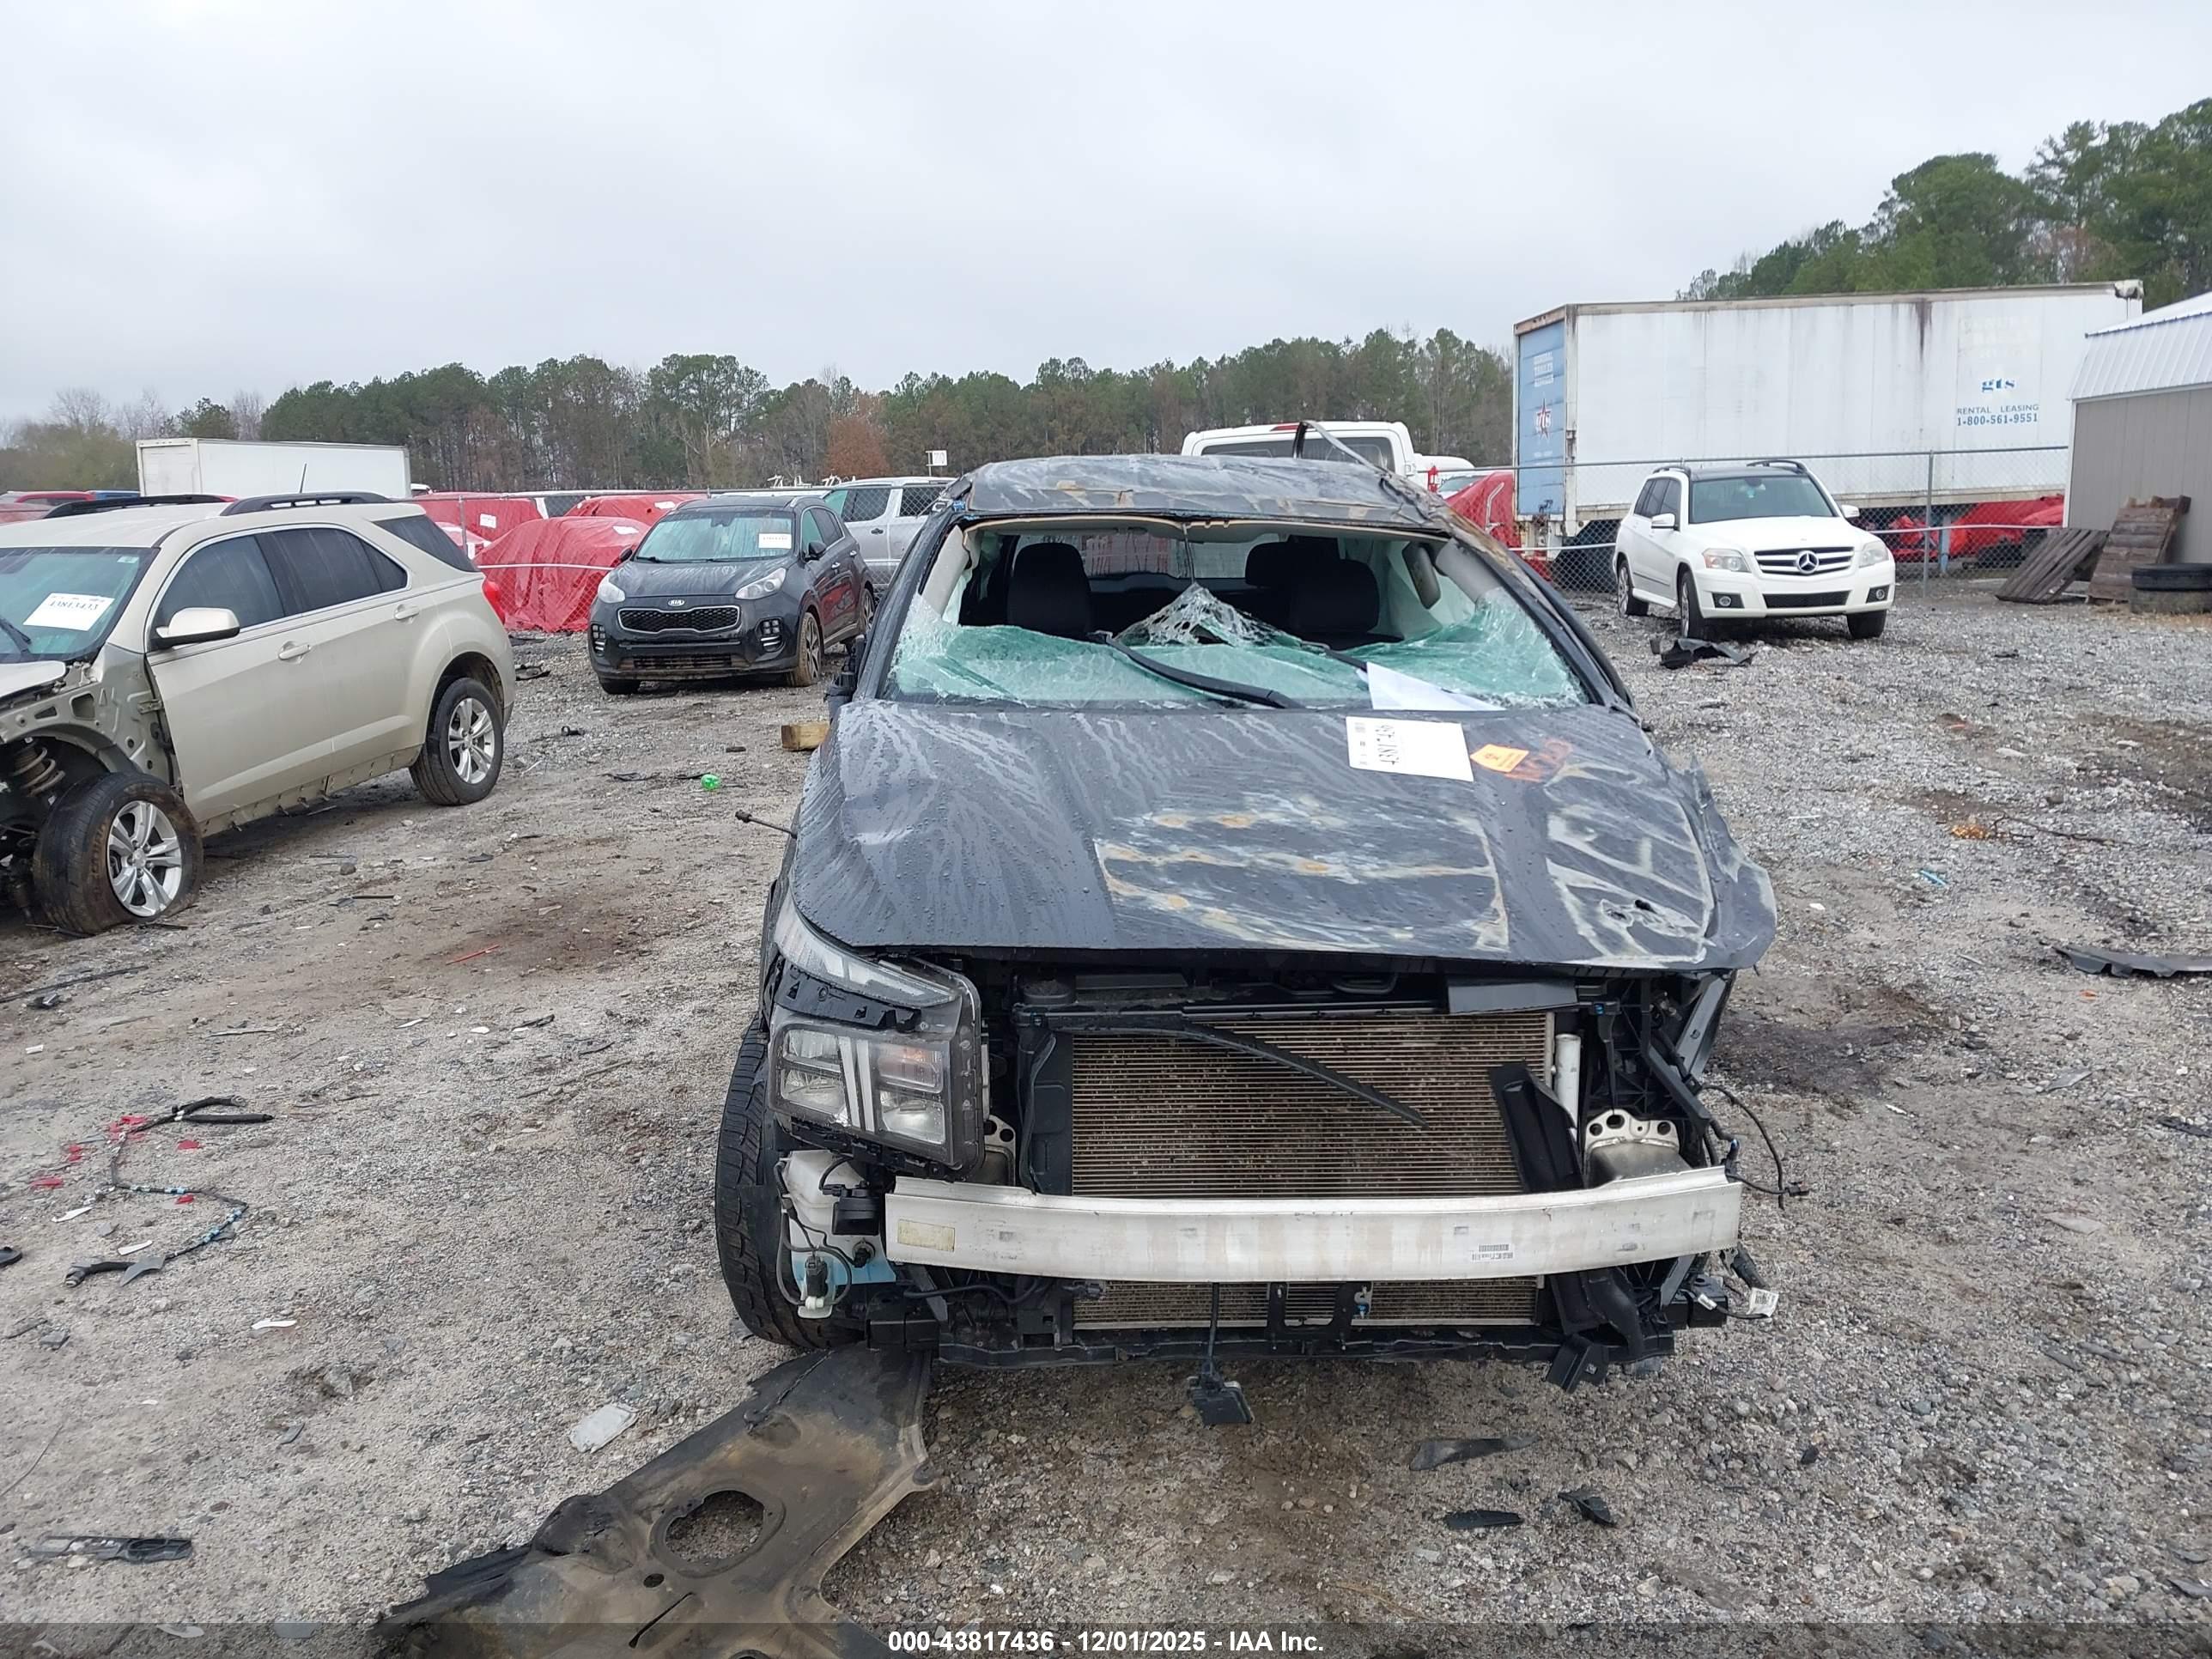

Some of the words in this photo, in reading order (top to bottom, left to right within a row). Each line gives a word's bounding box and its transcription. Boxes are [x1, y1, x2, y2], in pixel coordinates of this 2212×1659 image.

[1981, 378, 2015, 392] gts
[1957, 406, 1991, 415] RENTAL
[2000, 404, 2039, 413] LEASING
[1957, 413, 2039, 426] 1-800-561-9551
